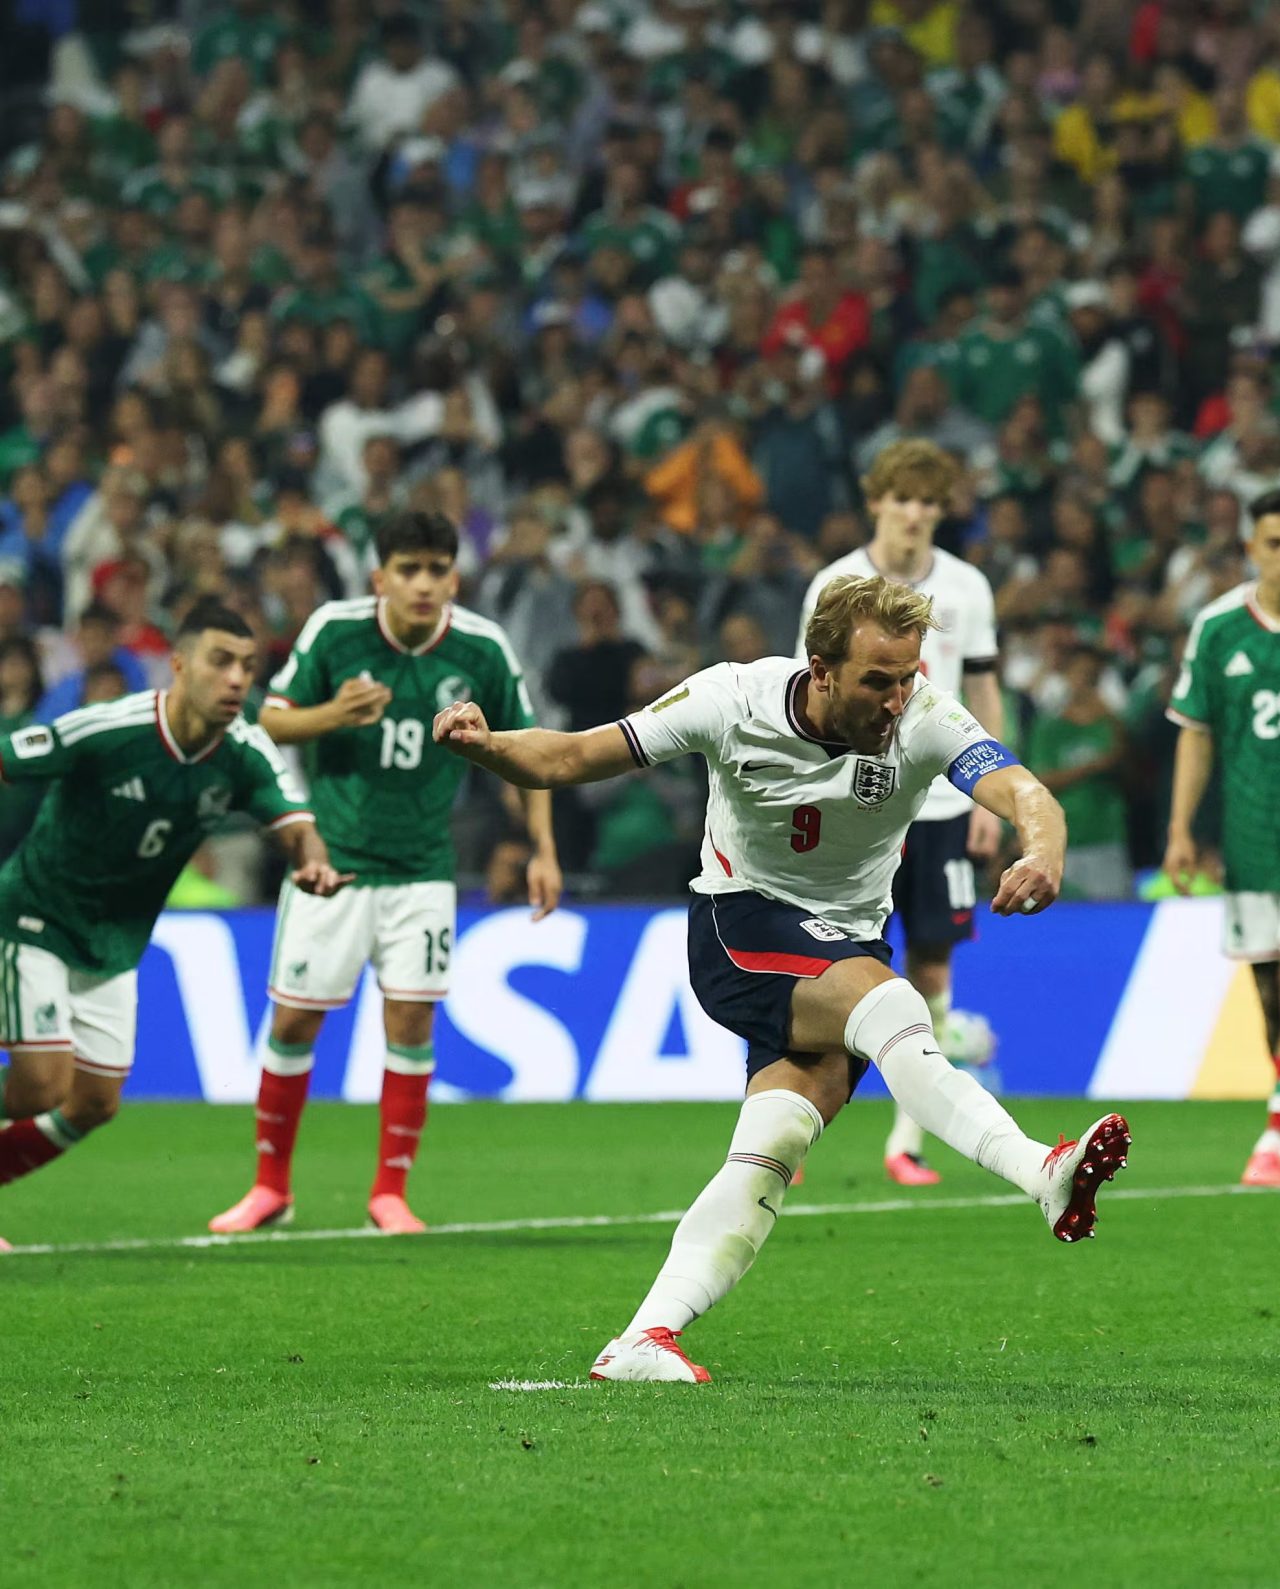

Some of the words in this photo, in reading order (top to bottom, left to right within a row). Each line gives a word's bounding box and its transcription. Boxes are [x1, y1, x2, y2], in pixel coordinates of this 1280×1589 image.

[380, 717, 425, 770] 19
[954, 743, 993, 768] FOOTBALL
[959, 748, 998, 774] UNITES
[964, 767, 979, 780] the
[977, 753, 1005, 769] World
[137, 818, 172, 859] 6
[790, 805, 822, 853] 9
